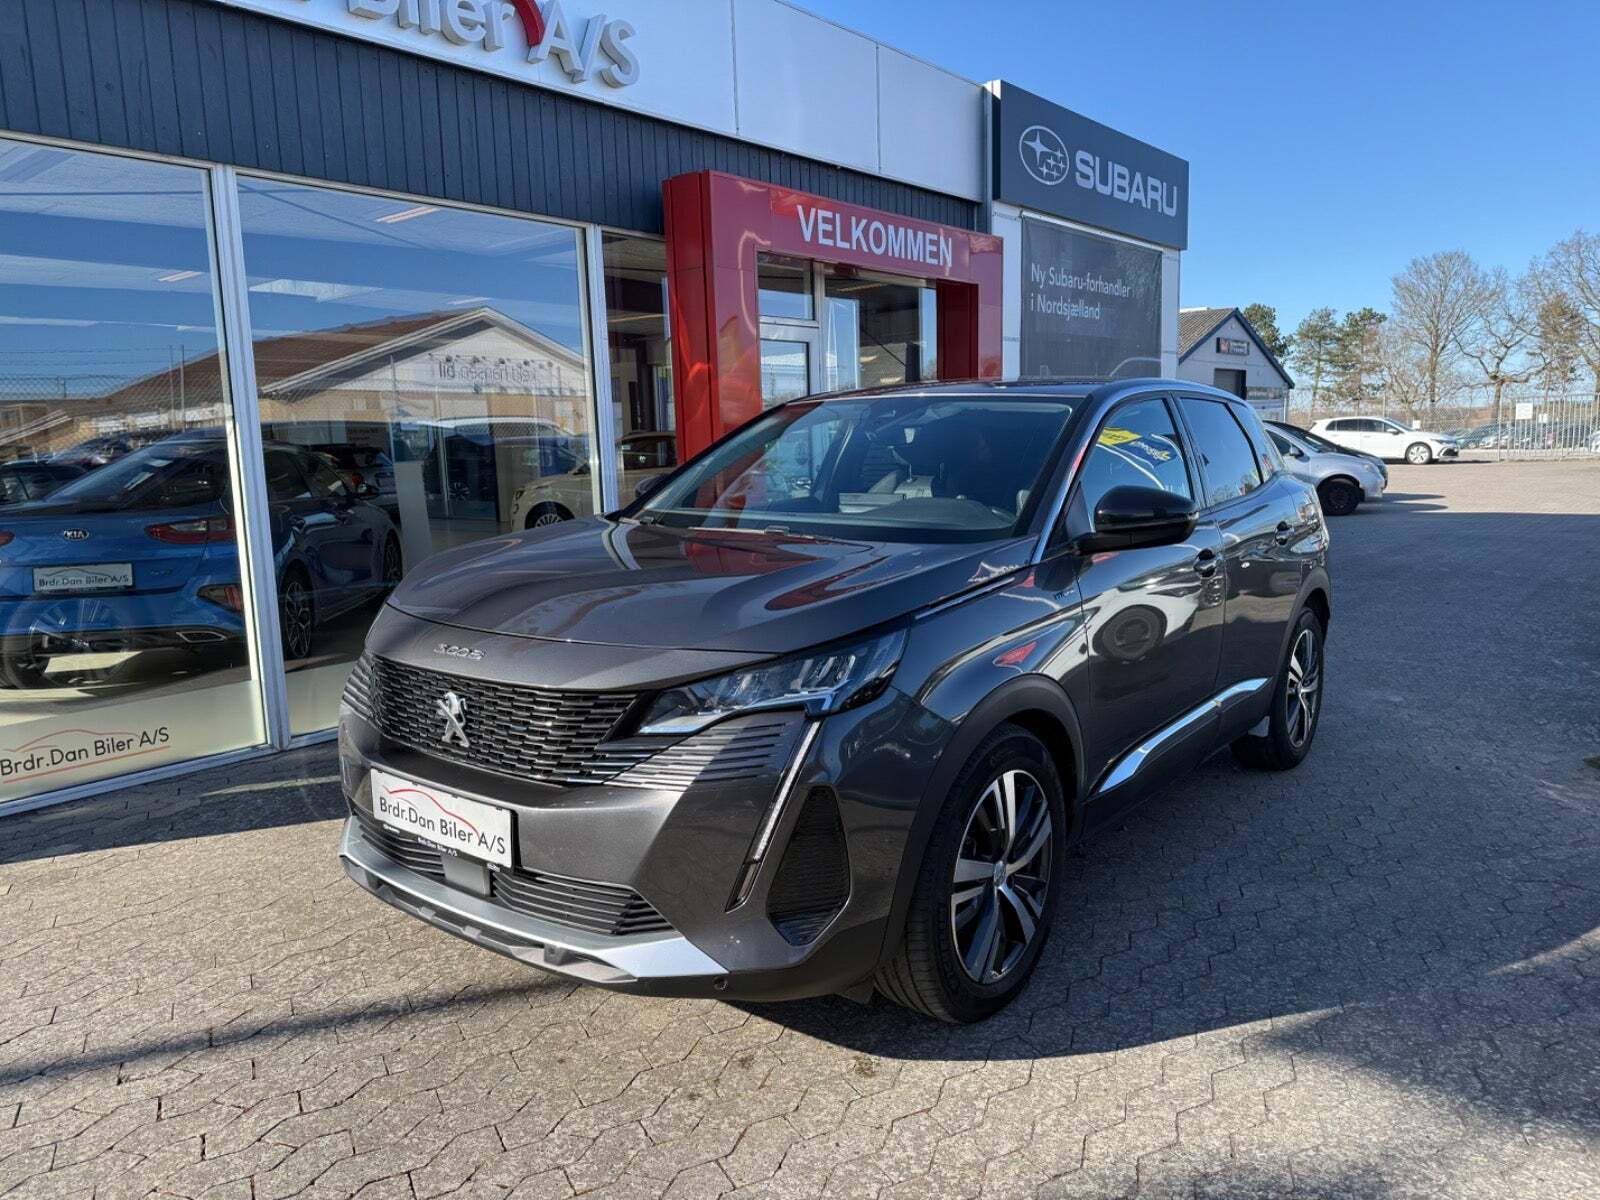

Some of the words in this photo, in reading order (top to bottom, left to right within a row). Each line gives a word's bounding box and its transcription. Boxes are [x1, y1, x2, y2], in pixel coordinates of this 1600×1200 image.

[348, 0, 515, 51] ler
[527, 0, 640, 89] A/S
[1075, 150, 1177, 217] SUBARU
[796, 204, 953, 268] VELKOMMEN
[1031, 262, 1046, 289] Ny
[1049, 267, 1131, 298] Subaru-forhandler
[1037, 294, 1100, 321] Nordsjælland
[94, 738, 133, 757] Biler
[139, 727, 169, 747] A/S
[440, 819, 473, 843] Biler
[478, 832, 506, 854] A/S
